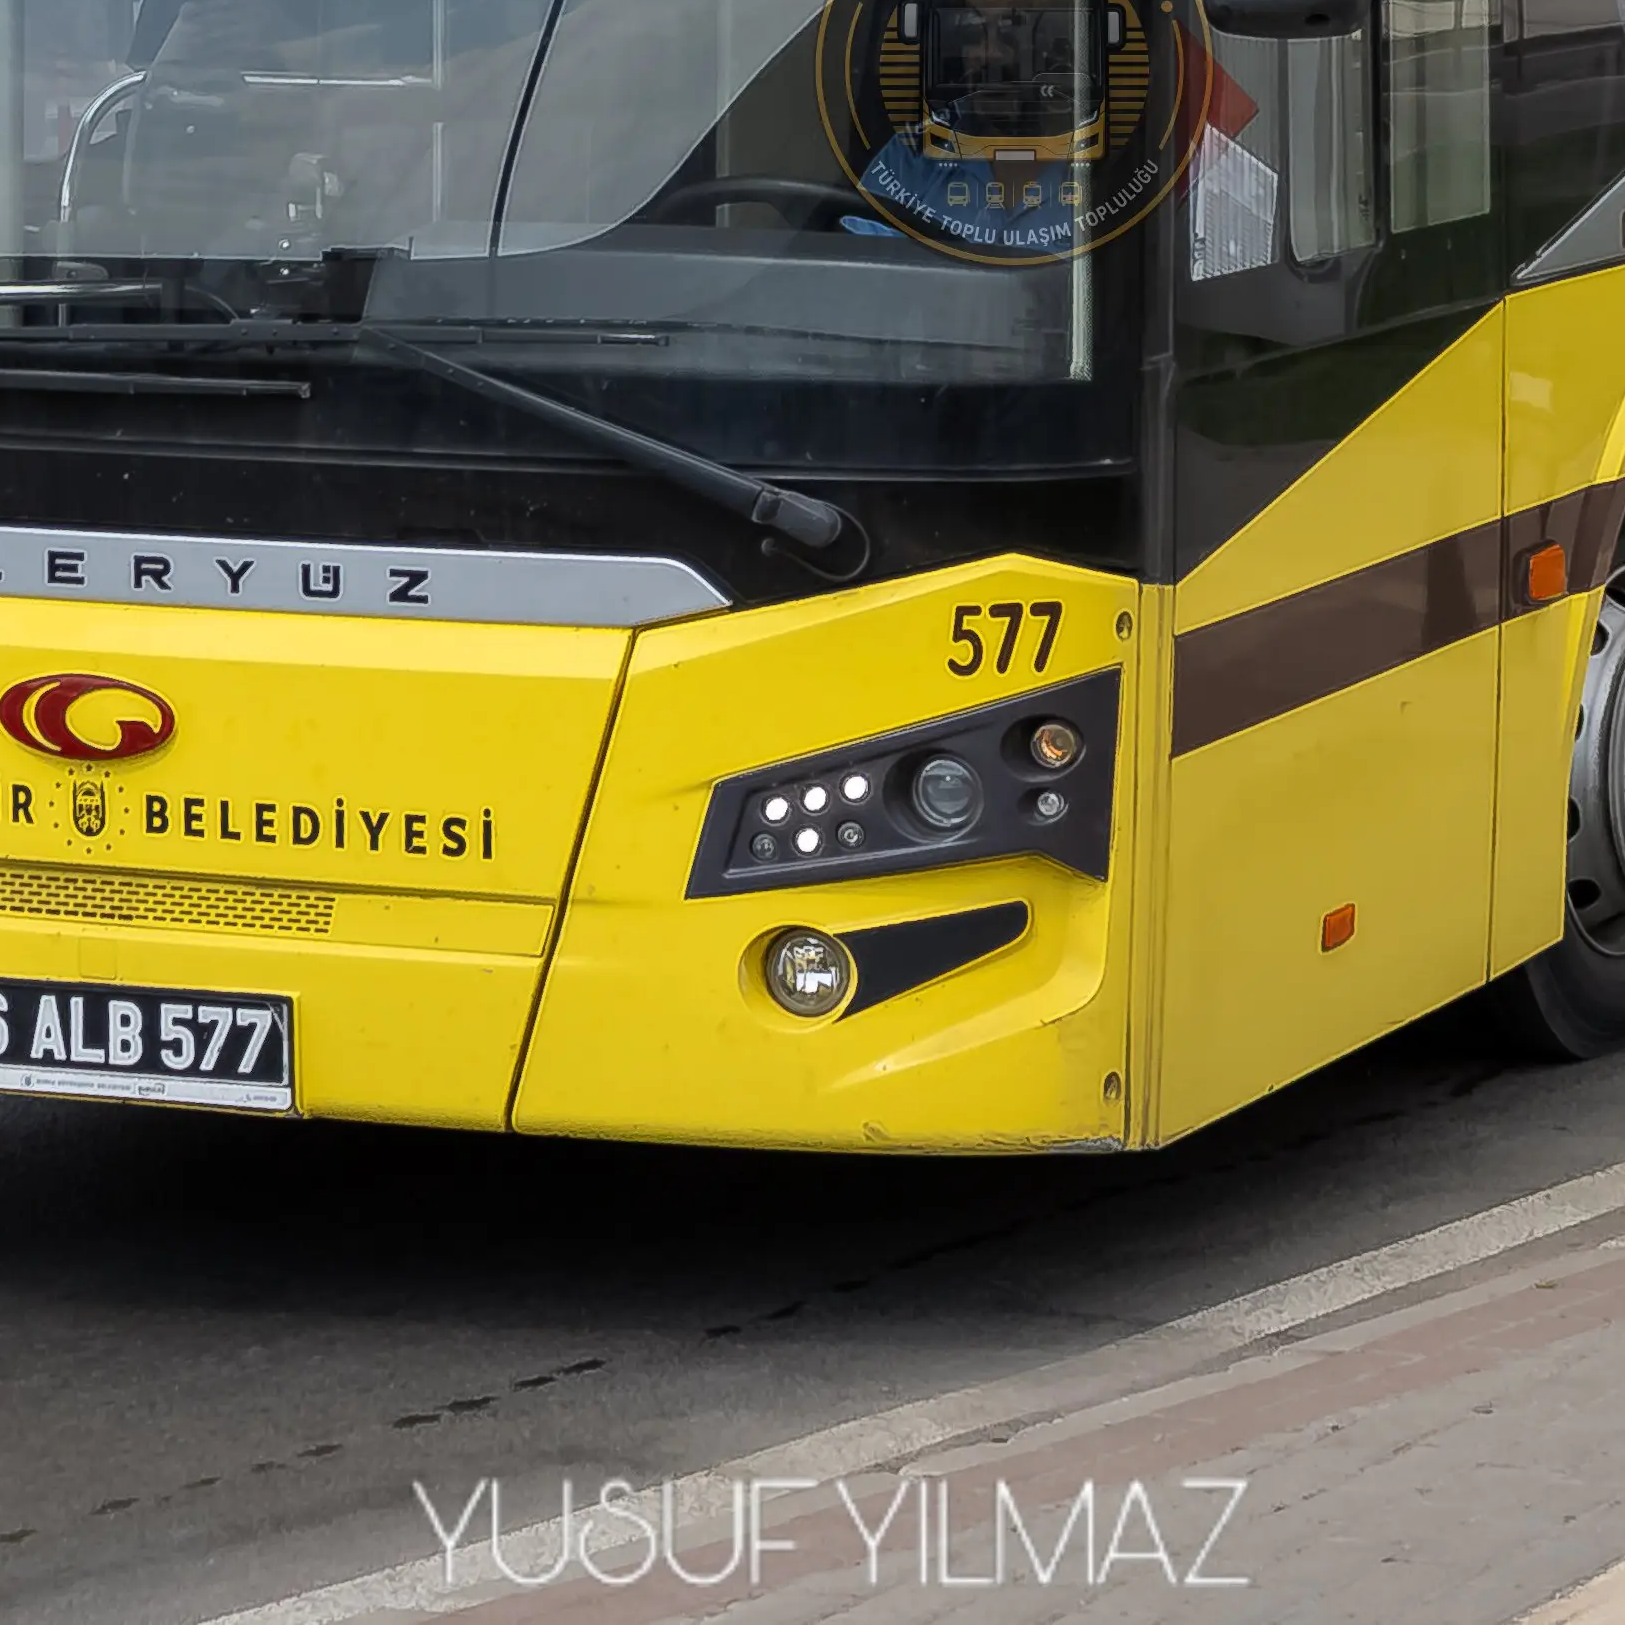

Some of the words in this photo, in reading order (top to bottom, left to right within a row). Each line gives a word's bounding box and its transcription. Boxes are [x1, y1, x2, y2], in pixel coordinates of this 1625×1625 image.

[947, 600, 1063, 676] 577
[145, 795, 494, 861] BELEDİYESİ
[30, 994, 143, 1068] ALB
[159, 1002, 274, 1075] 577
